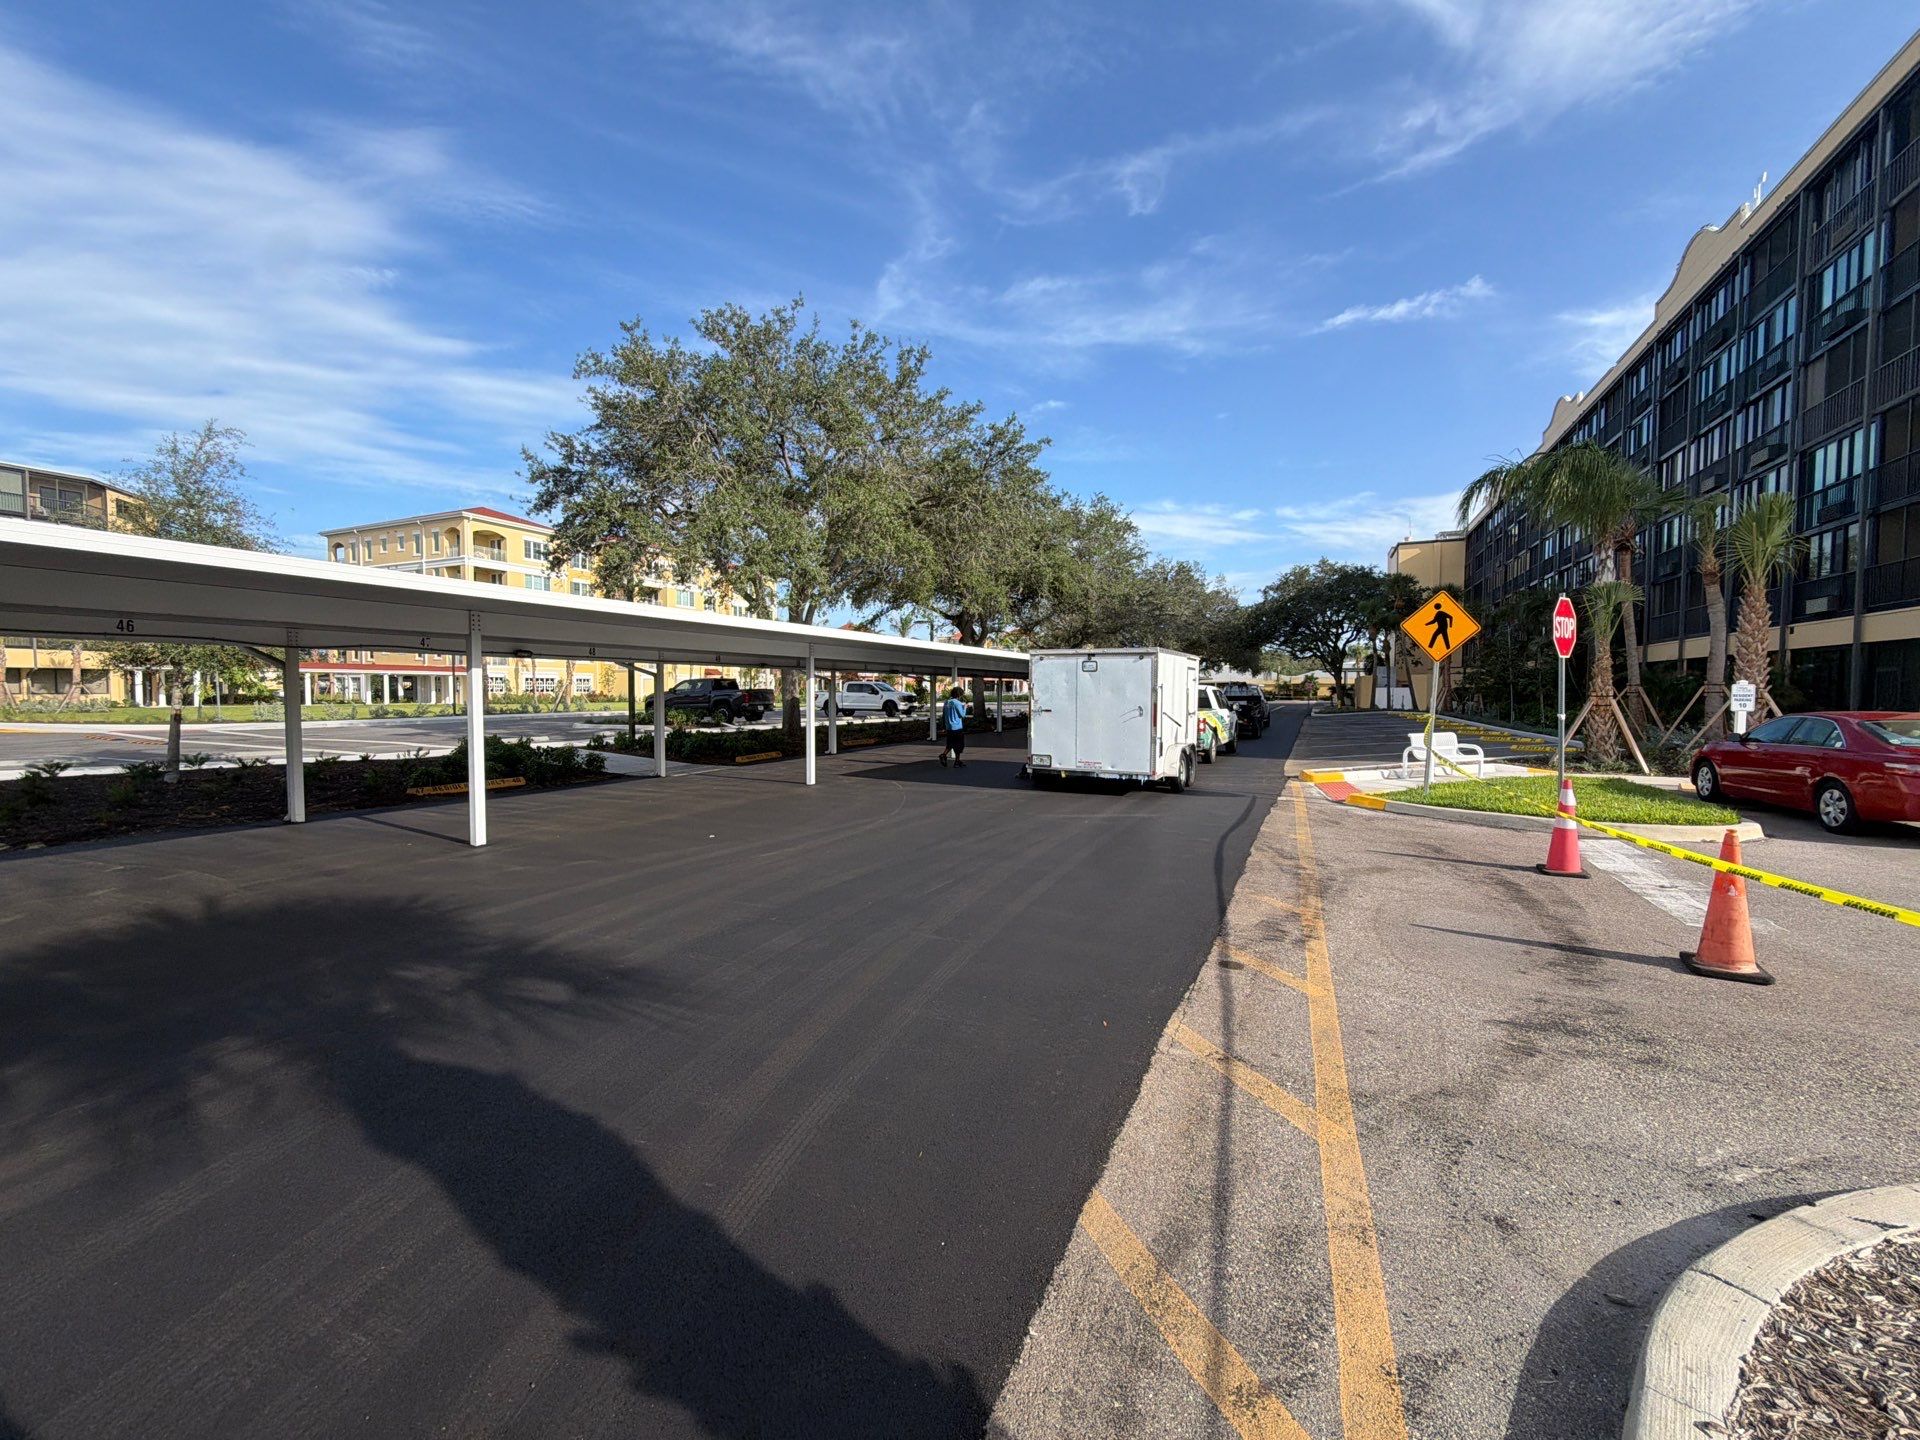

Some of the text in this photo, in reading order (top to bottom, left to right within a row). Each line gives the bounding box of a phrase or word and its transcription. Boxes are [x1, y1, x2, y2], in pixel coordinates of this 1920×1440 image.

[116, 619, 134, 632] 46
[1555, 616, 1574, 638] STOP
[420, 637, 430, 647] 47
[588, 647, 596, 656] 48
